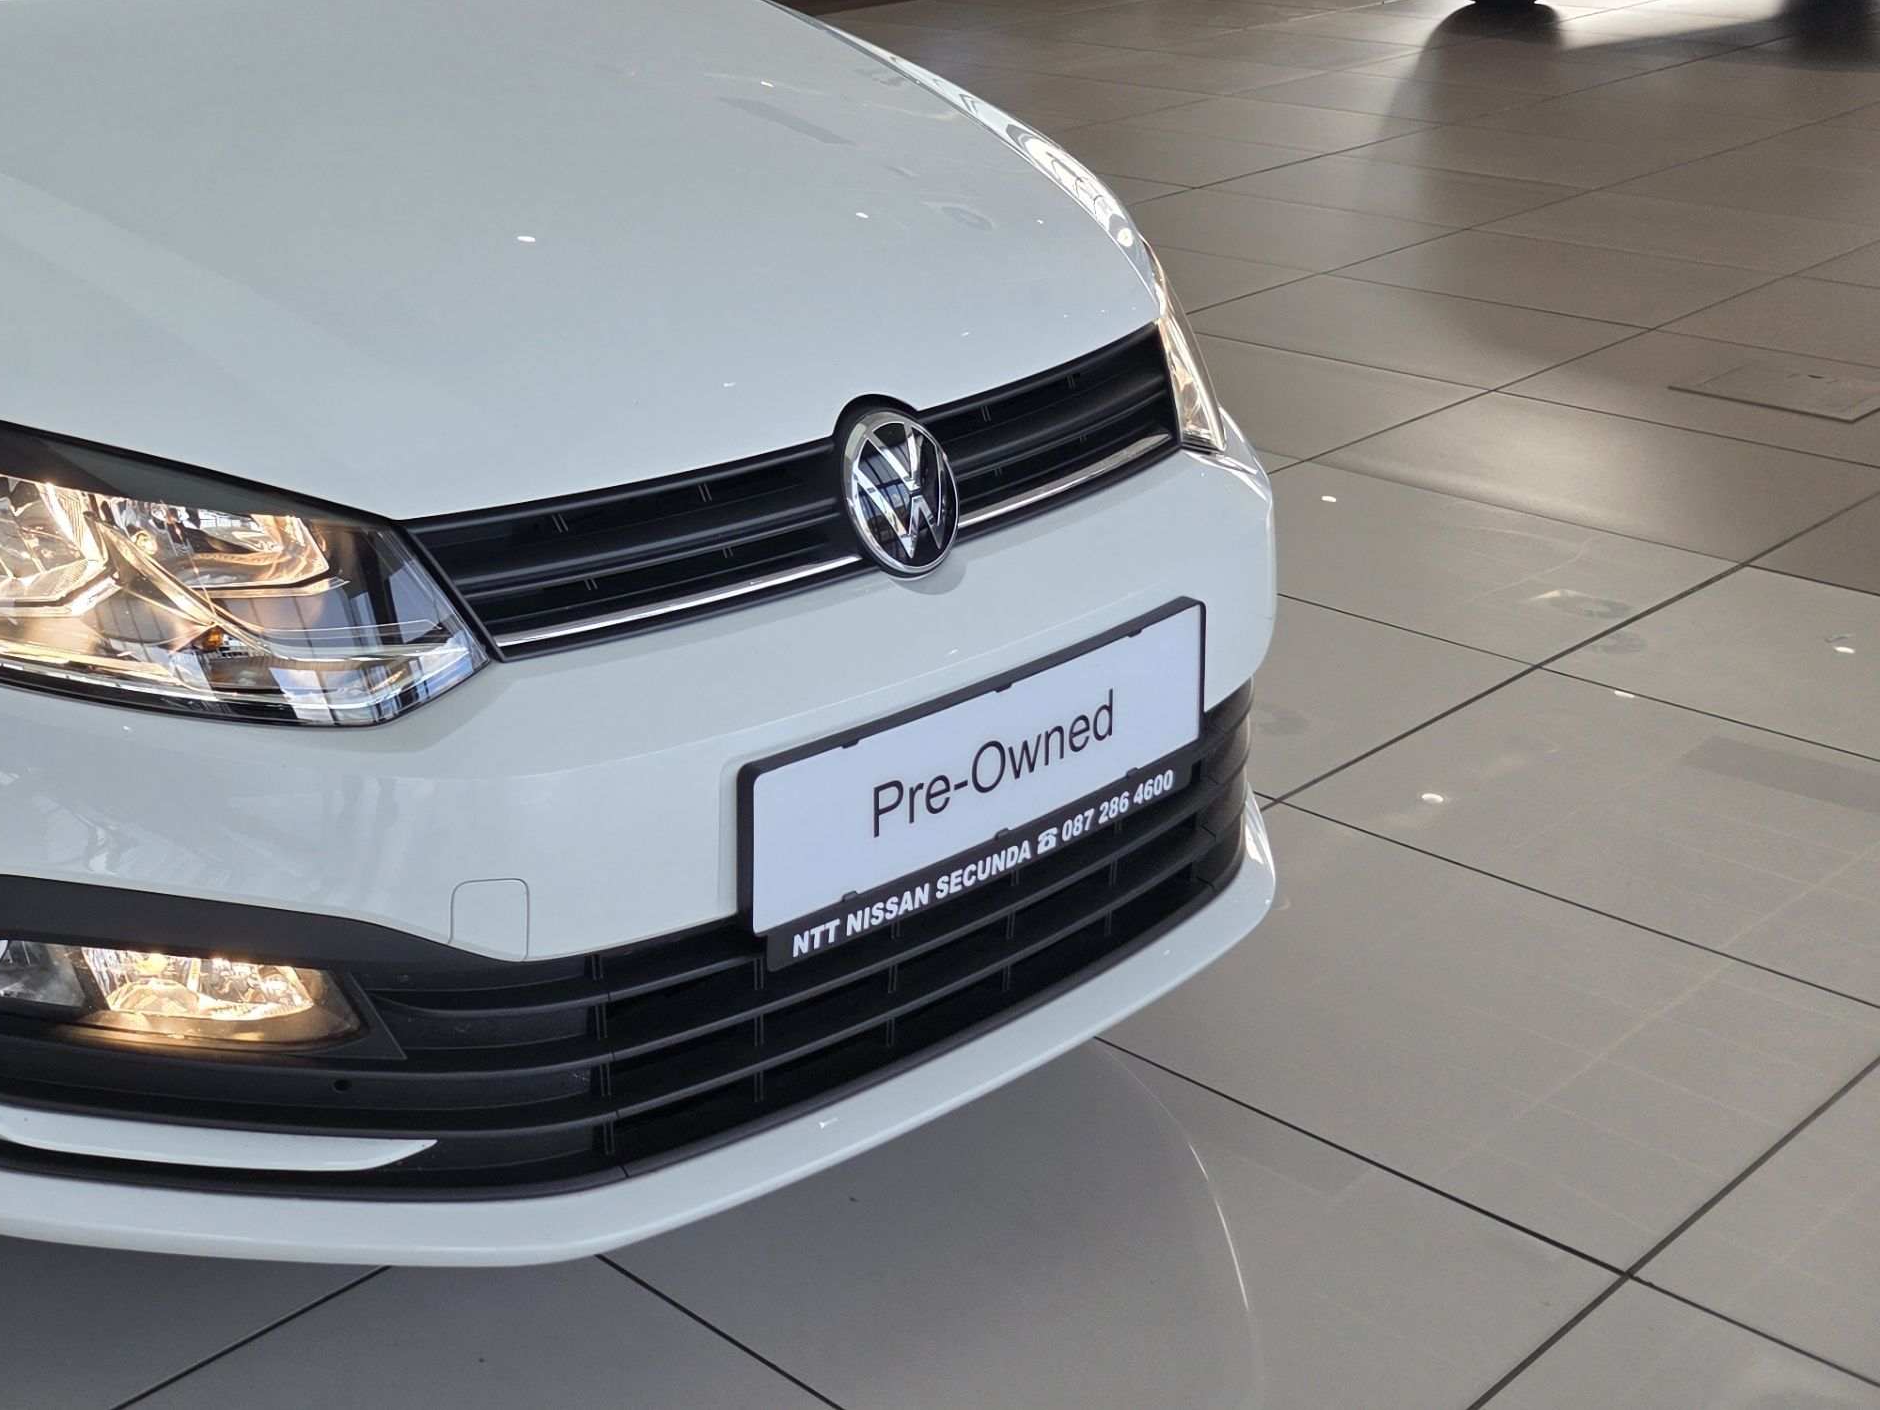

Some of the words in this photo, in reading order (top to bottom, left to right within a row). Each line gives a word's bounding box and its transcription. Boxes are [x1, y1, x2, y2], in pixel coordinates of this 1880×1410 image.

[872, 686, 1114, 839] Pre-Owned
[792, 918, 841, 958] NTT
[846, 883, 930, 937] NISSAN
[935, 840, 1032, 900] SECUNDA
[1061, 808, 1095, 842] 087
[1098, 791, 1130, 824] 286
[1133, 769, 1174, 805] 4600
